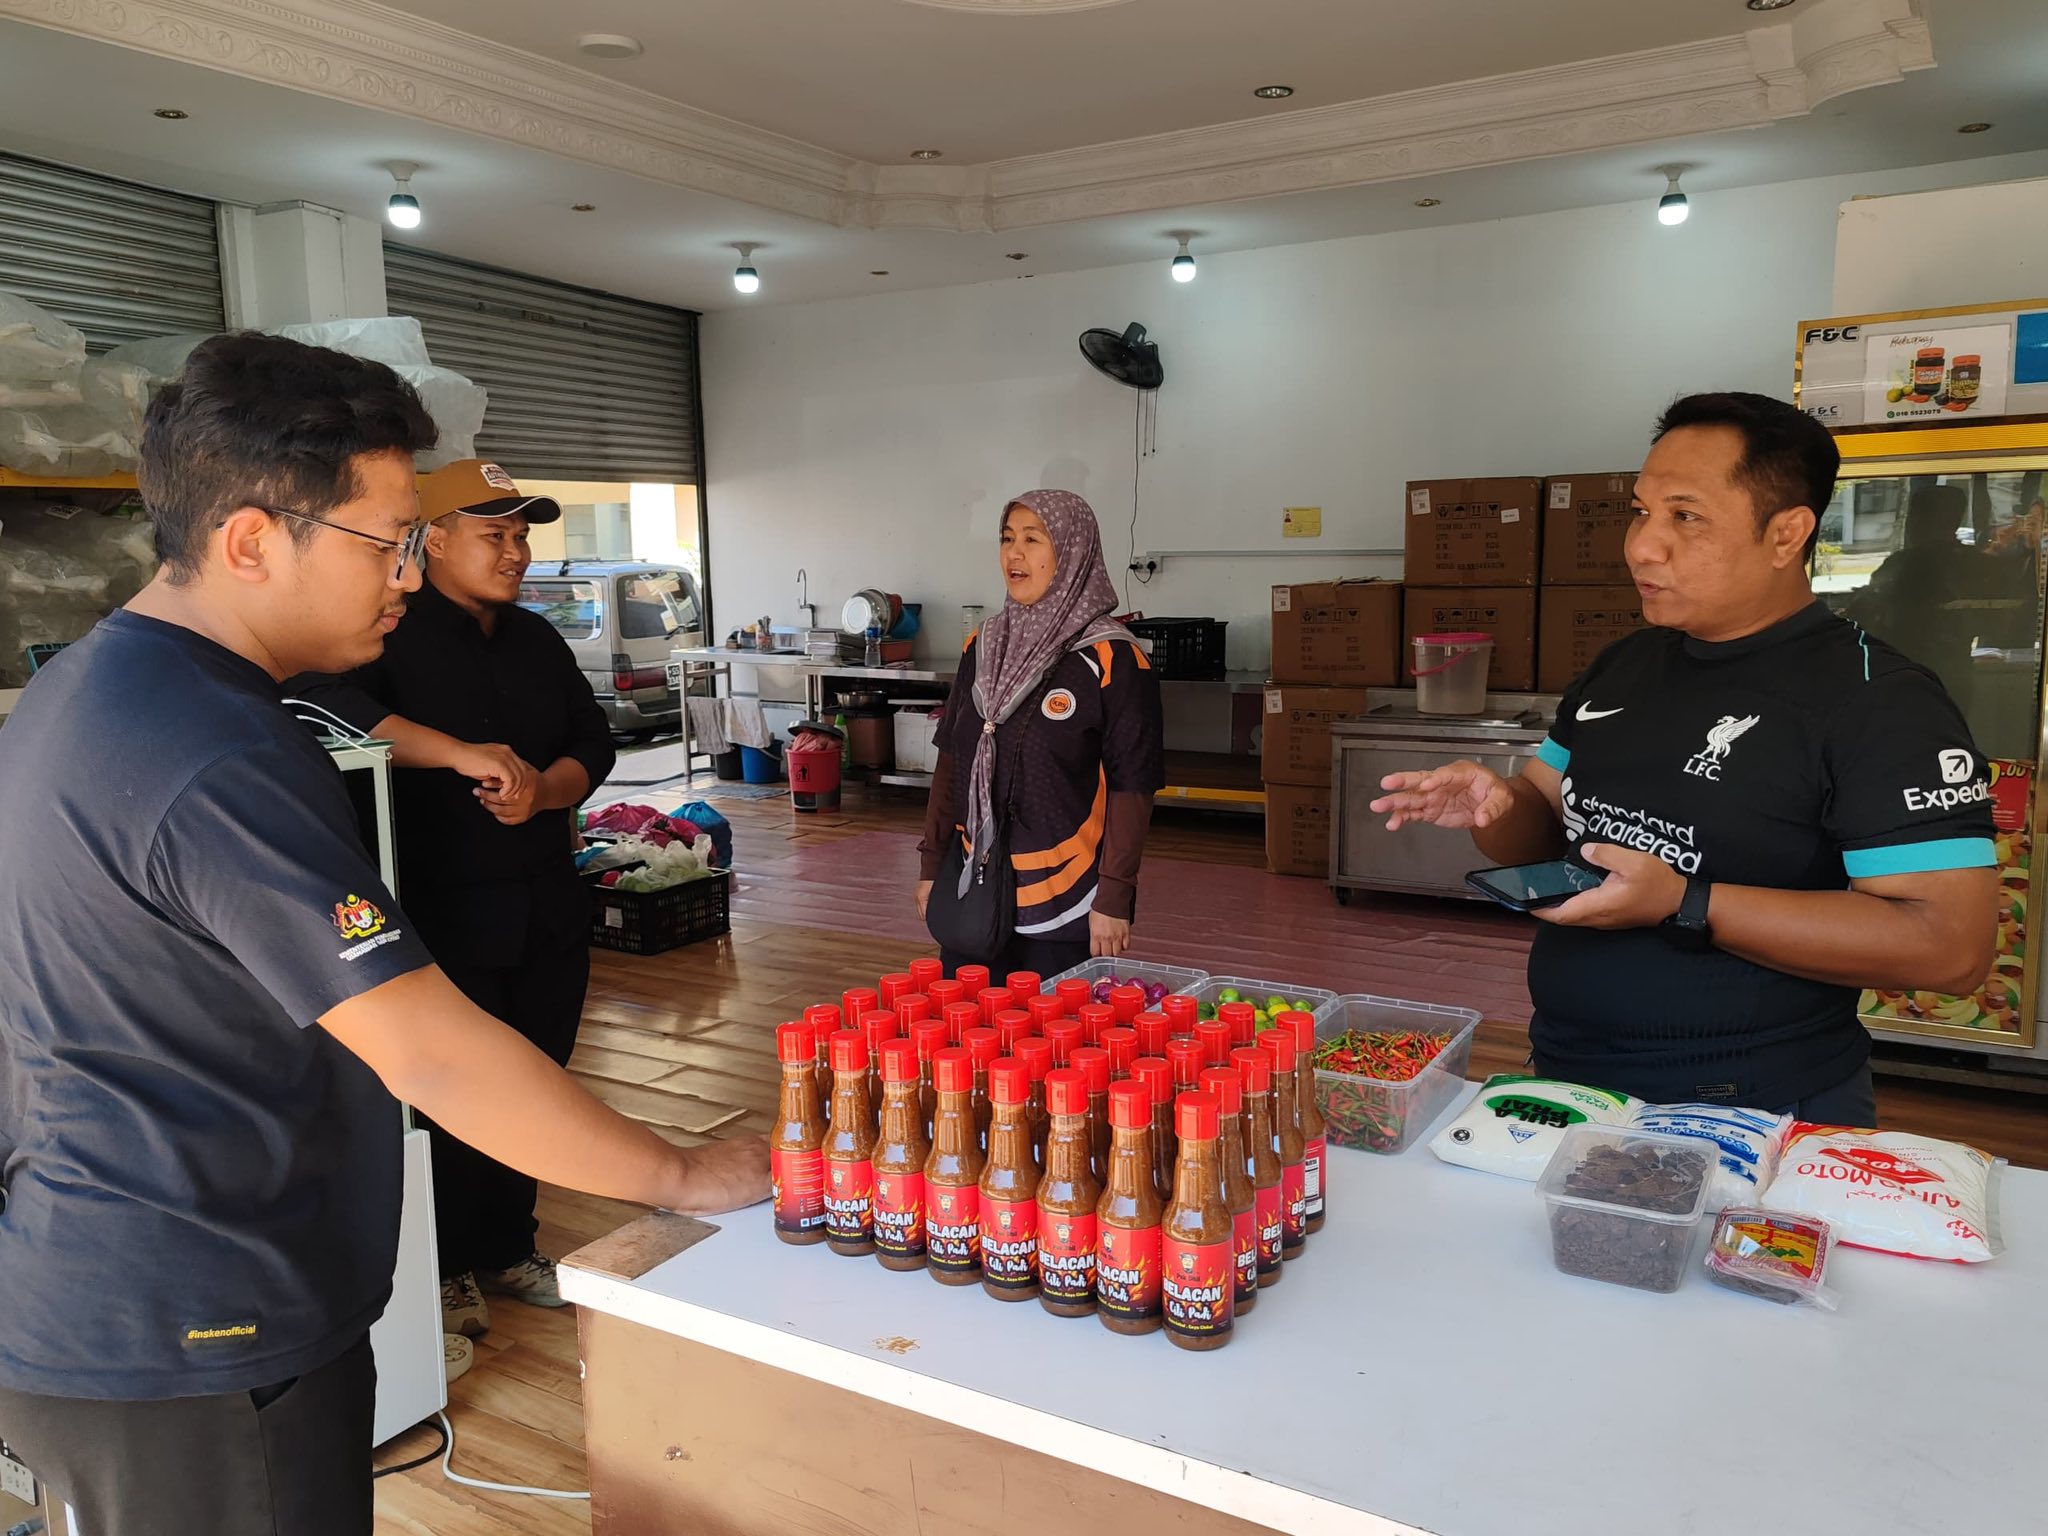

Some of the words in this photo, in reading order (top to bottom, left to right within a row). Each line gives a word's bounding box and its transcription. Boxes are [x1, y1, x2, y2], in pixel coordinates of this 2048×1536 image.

[1806, 326, 1859, 344] F&C
[1582, 796, 1695, 847] standard
[1588, 813, 1702, 875] chartered
[1495, 1107, 1569, 1128] GULA
[1501, 1099, 1570, 1118] PRAI
[982, 1235, 1036, 1256] BELACAN
[1007, 1258, 1028, 1272] Padi
[1040, 1250, 1094, 1271] BELACAN
[1065, 1273, 1086, 1288] Padi
[1164, 1278, 1221, 1301] BELACAN
[1189, 1305, 1212, 1320] Padi
[187, 1324, 256, 1340] #inskenofficial
